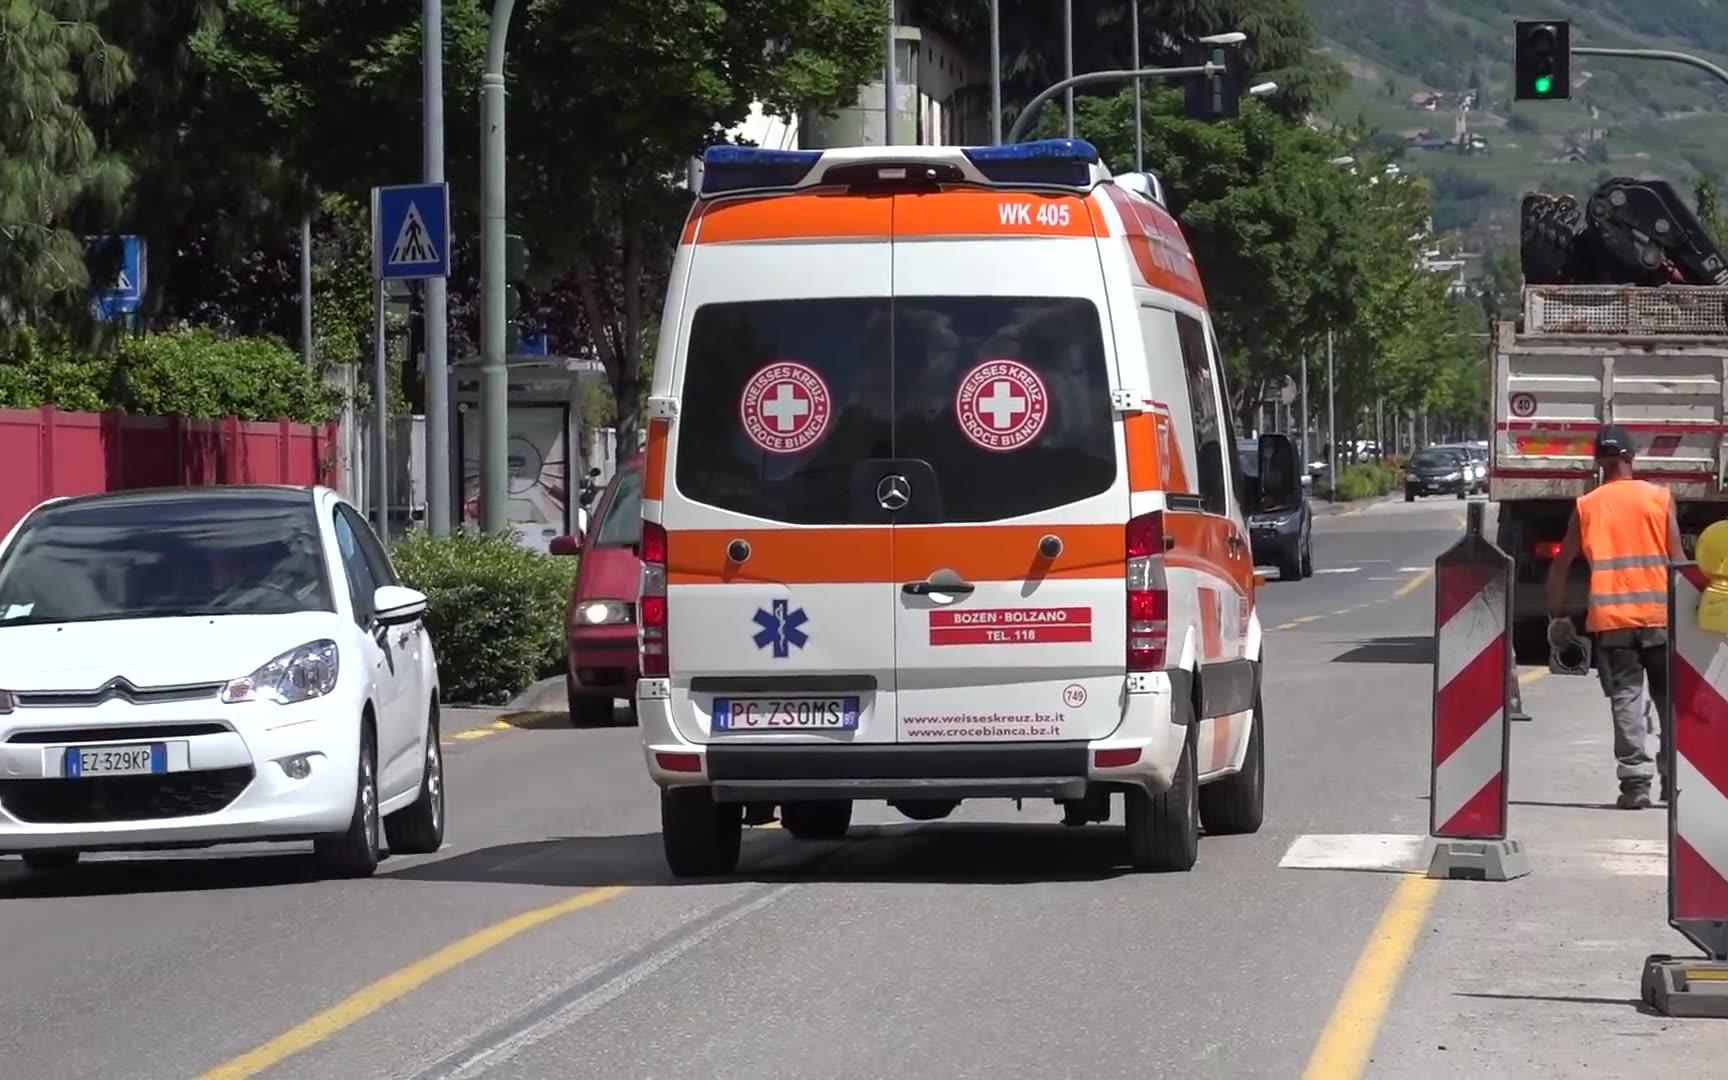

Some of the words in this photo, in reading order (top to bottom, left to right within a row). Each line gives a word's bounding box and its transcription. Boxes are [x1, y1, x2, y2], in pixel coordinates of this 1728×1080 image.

[998, 203, 1031, 225] WK
[1036, 203, 1070, 227] 405
[746, 367, 791, 406] WEISSES
[791, 368, 825, 404] KREUZ
[961, 364, 1007, 402] WEISSES
[1008, 366, 1042, 402] KREUZ
[1517, 399, 1530, 412] 40
[747, 415, 783, 448] CROCE
[784, 414, 825, 448] BIANCA
[962, 411, 999, 446] CROCE
[1001, 411, 1042, 446] BIANCA
[954, 612, 998, 624] BOZEN
[1004, 610, 1067, 623] BOLZANO
[986, 630, 1011, 641] TEL.
[1014, 629, 1036, 641] 118
[1066, 690, 1084, 702] 749
[731, 702, 758, 727] PC
[903, 712, 1065, 724] www.weisseskreuz.bz.it
[908, 725, 1061, 737] www.crocebianca.bz.it
